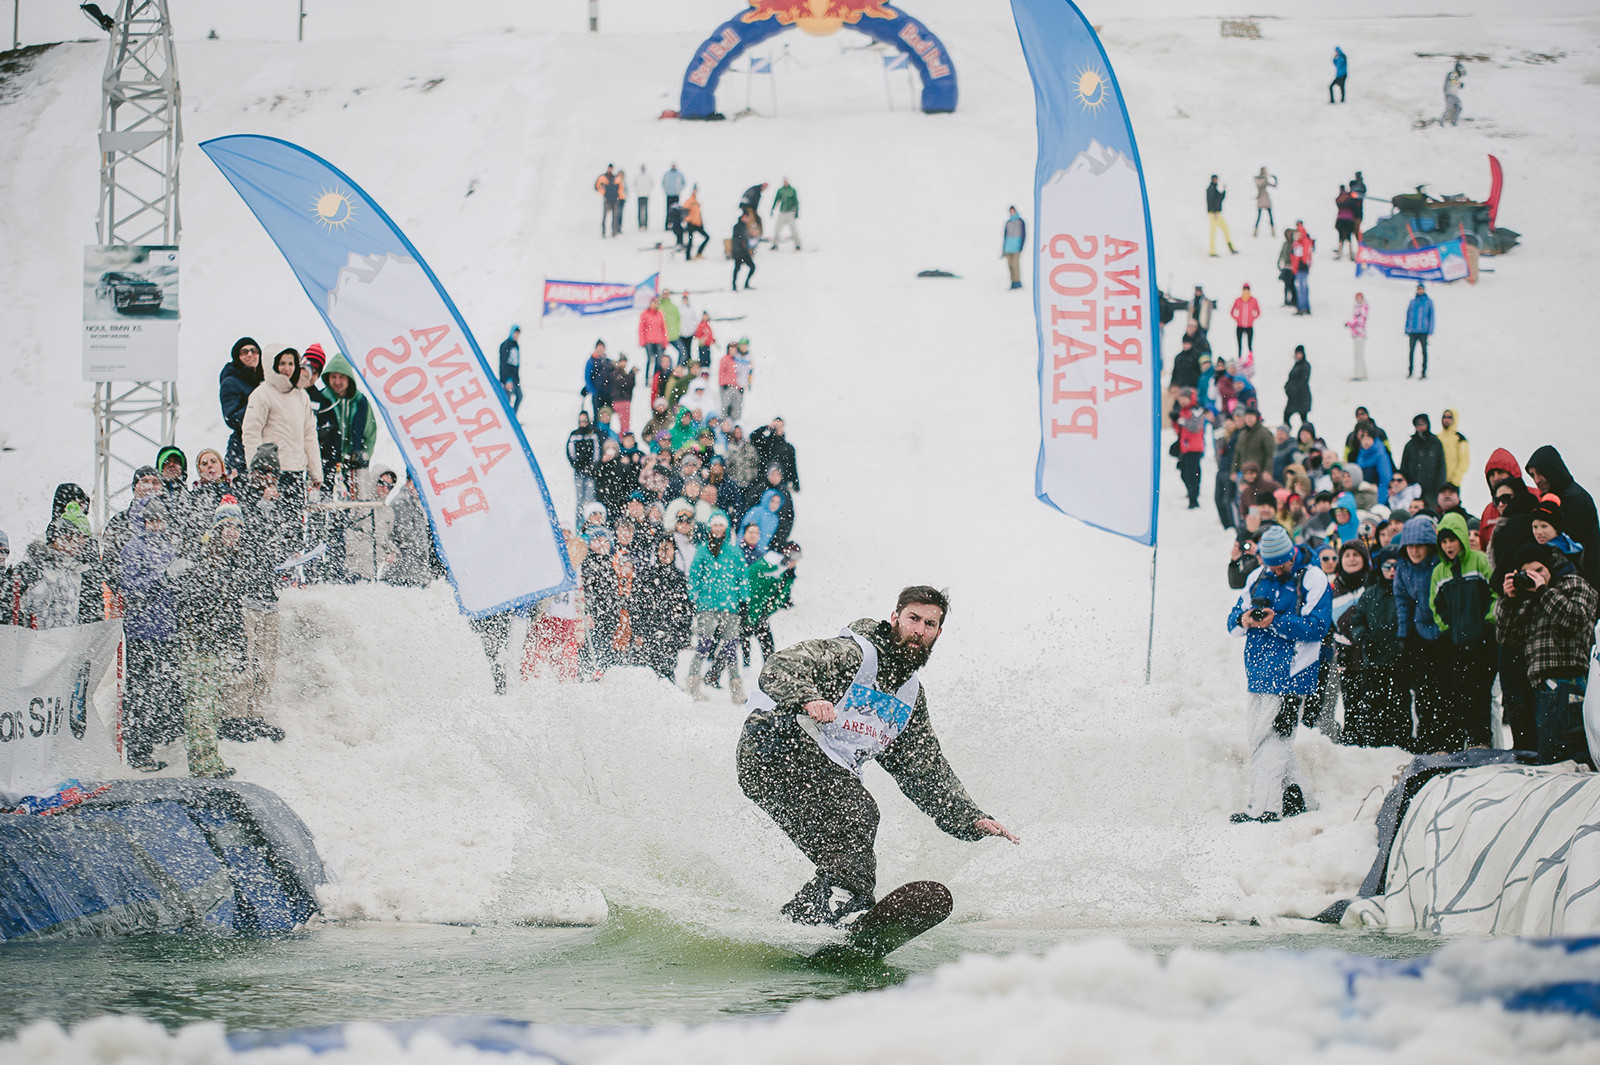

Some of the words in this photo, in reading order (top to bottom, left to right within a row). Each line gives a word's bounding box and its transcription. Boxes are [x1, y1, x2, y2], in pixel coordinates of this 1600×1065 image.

[688, 51, 719, 88] Red
[706, 27, 742, 61] Bull
[897, 22, 935, 56] Red
[921, 47, 951, 80] Bull
[109, 324, 131, 333] BMW
[842, 719, 877, 738] ARENA
